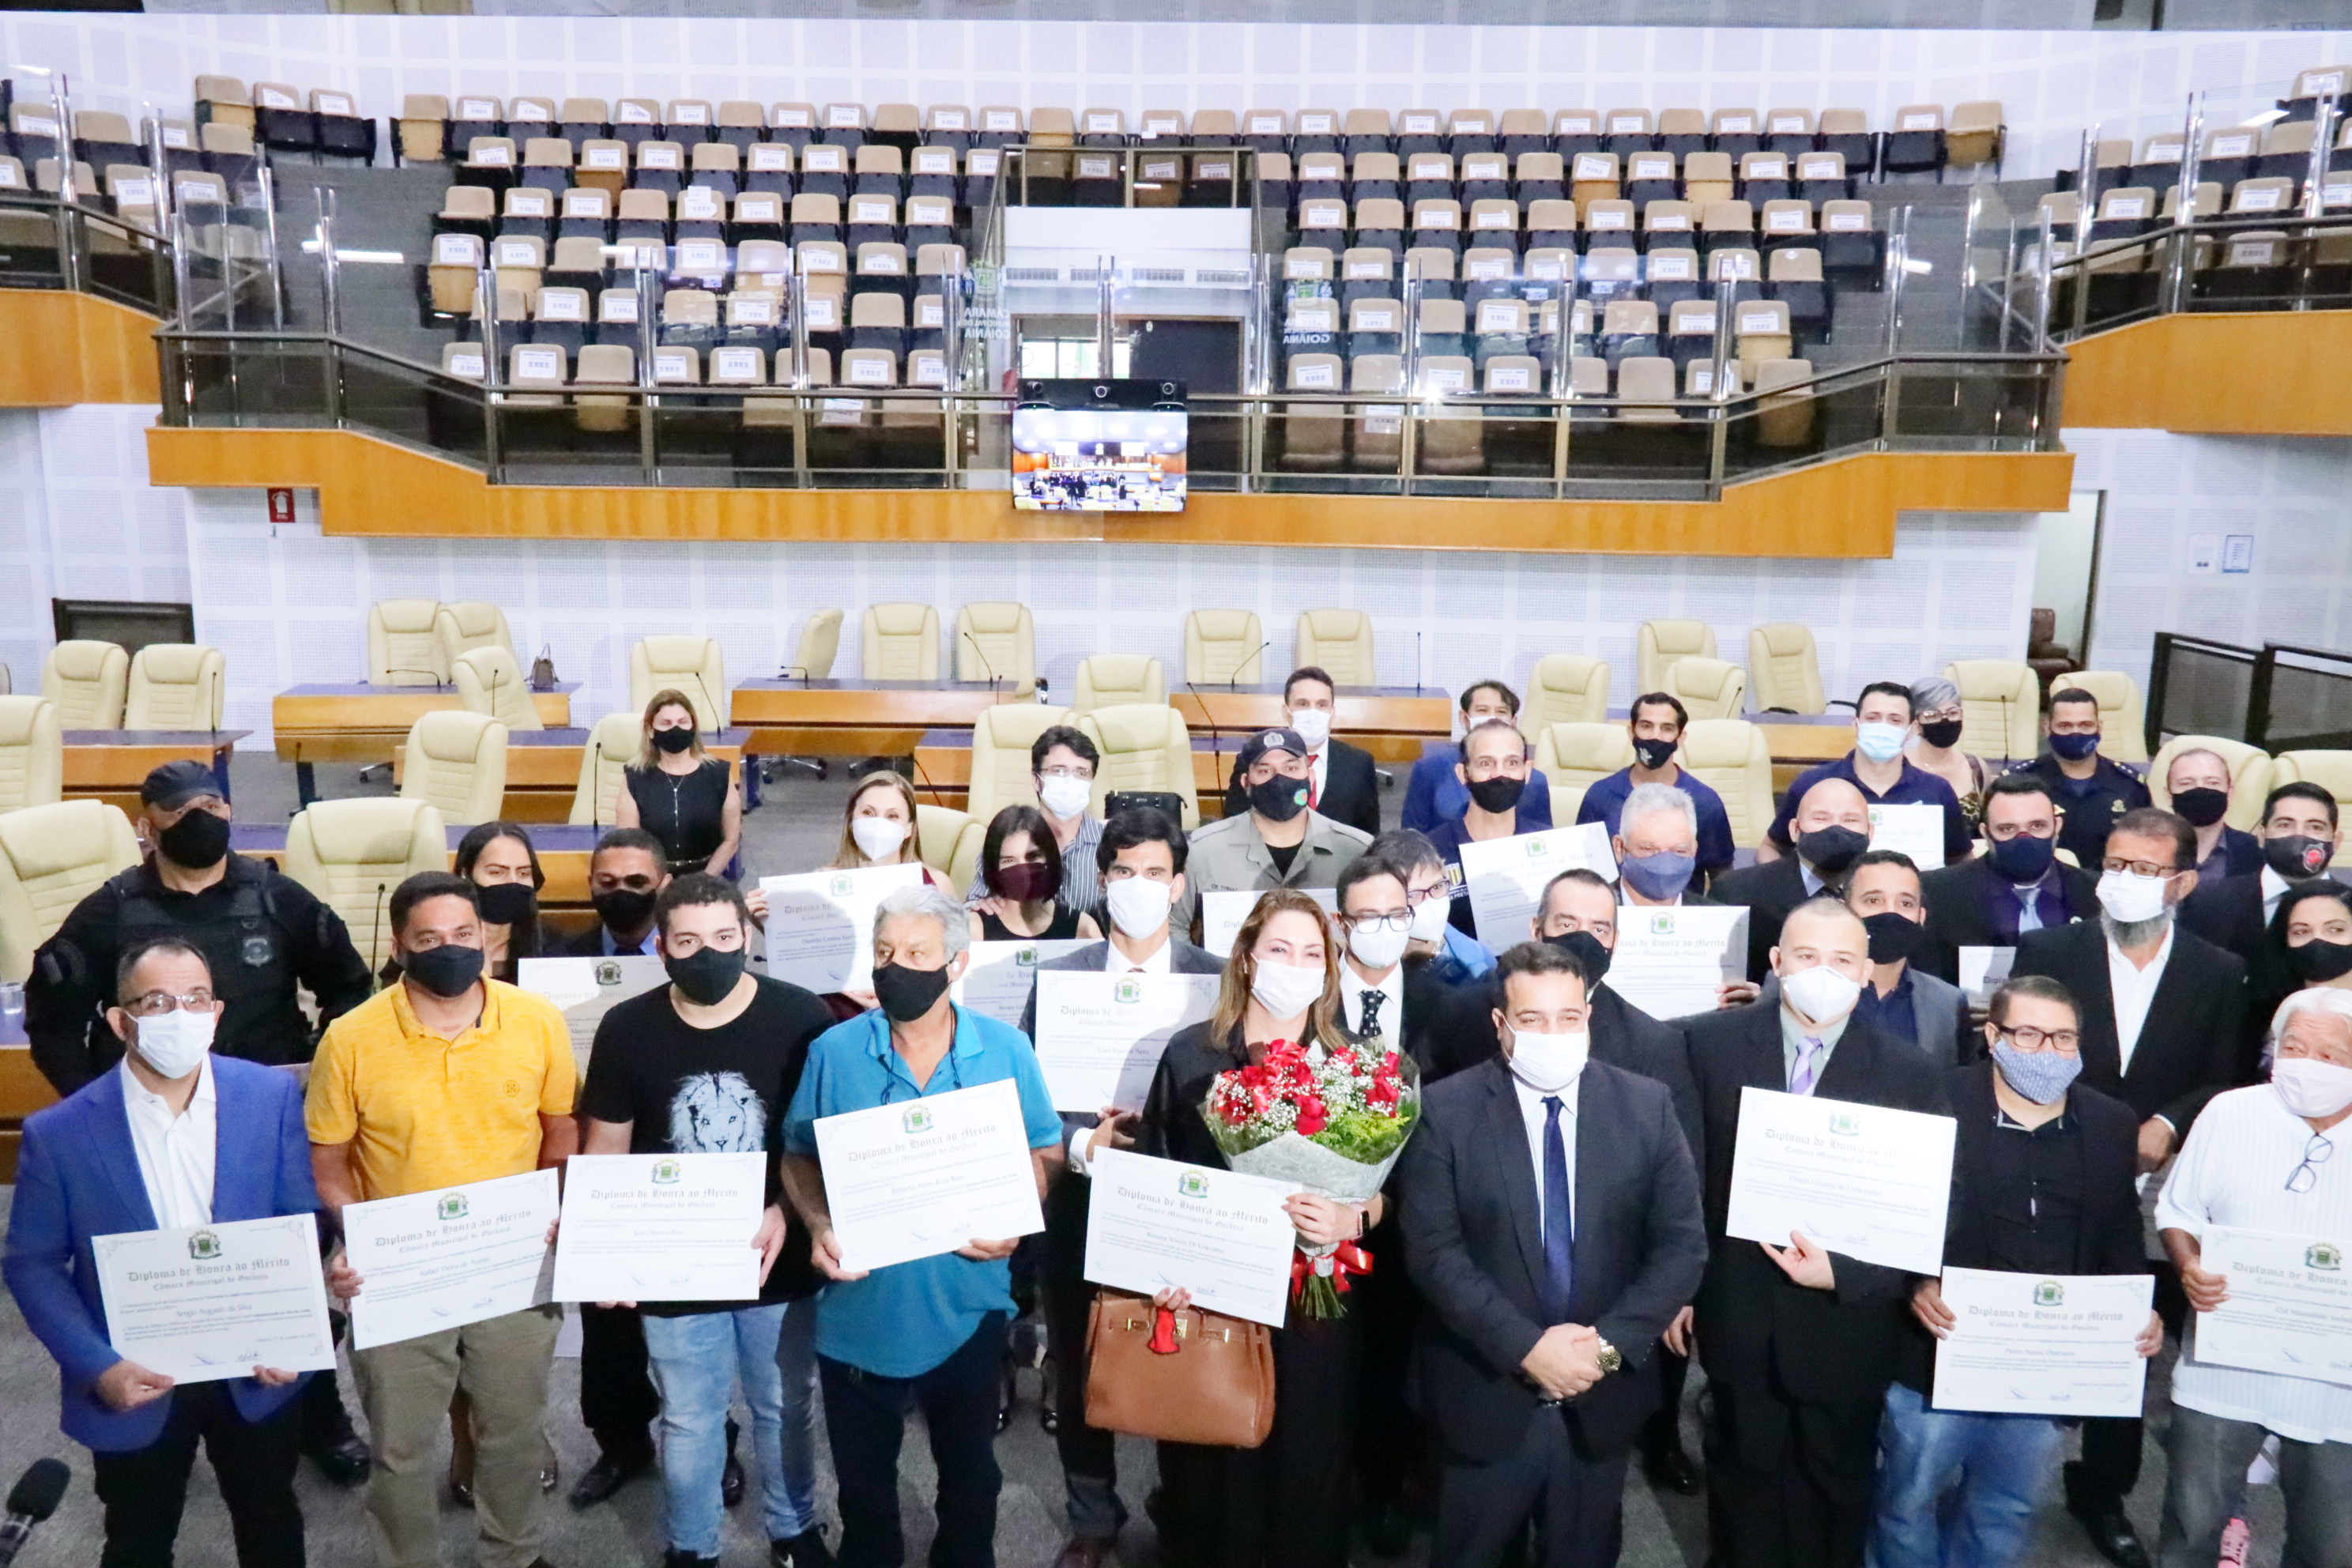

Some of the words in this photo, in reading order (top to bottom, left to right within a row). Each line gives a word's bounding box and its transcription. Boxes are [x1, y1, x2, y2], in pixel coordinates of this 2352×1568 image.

[1652, 938, 1679, 947] Honra
[1060, 1005, 1099, 1016] Diploma
[846, 1146, 891, 1163] Diploma
[894, 1143, 906, 1152] de
[908, 1136, 943, 1150] Honra
[945, 1133, 957, 1141] ao
[960, 1124, 997, 1140] Mérito
[1763, 1127, 1810, 1144] Diploma
[1813, 1136, 1825, 1147] de
[1829, 1138, 1864, 1153] Honra
[870, 1158, 899, 1169] Câmara
[901, 1148, 937, 1163] Municipal
[948, 1141, 977, 1152] Goiânia
[591, 1189, 633, 1200] Diploma
[637, 1189, 647, 1197] de
[652, 1189, 684, 1198] Honra
[702, 1186, 737, 1197] Mérito
[891, 1185, 916, 1194] Roberto
[1811, 1178, 1836, 1189] Ferreira
[1846, 1185, 1862, 1193] Lima
[1117, 1185, 1161, 1204] Diploma
[1163, 1196, 1175, 1207] de
[1179, 1199, 1212, 1215] Honra
[1216, 1208, 1227, 1217] ao
[1231, 1209, 1268, 1224] Mérito
[374, 1232, 422, 1247] Diploma
[425, 1229, 437, 1238] de
[442, 1221, 476, 1234] Honra
[495, 1210, 531, 1224] Mérito
[398, 1243, 428, 1253] Câmara
[431, 1234, 469, 1248] Municipal
[481, 1227, 510, 1237] Goiânia
[1146, 1231, 1167, 1241] Renata
[1168, 1236, 1187, 1245] Souza
[126, 1269, 175, 1282] Diploma
[179, 1267, 190, 1276] de
[195, 1264, 231, 1275] Honra
[235, 1262, 247, 1271] ao
[251, 1257, 289, 1270] Mérito
[419, 1267, 439, 1276] Rafael
[2231, 1261, 2285, 1277] Diploma
[2288, 1270, 2301, 1279] de
[2307, 1272, 2347, 1286] Honra
[152, 1282, 183, 1291] Câmara
[186, 1276, 225, 1287] Municipal
[237, 1272, 268, 1281] Goiânia
[198, 1306, 225, 1315] Augusto
[1968, 1305, 2015, 1317] Diploma
[2034, 1310, 2067, 1320] Honra
[2086, 1311, 2123, 1321] Mérito
